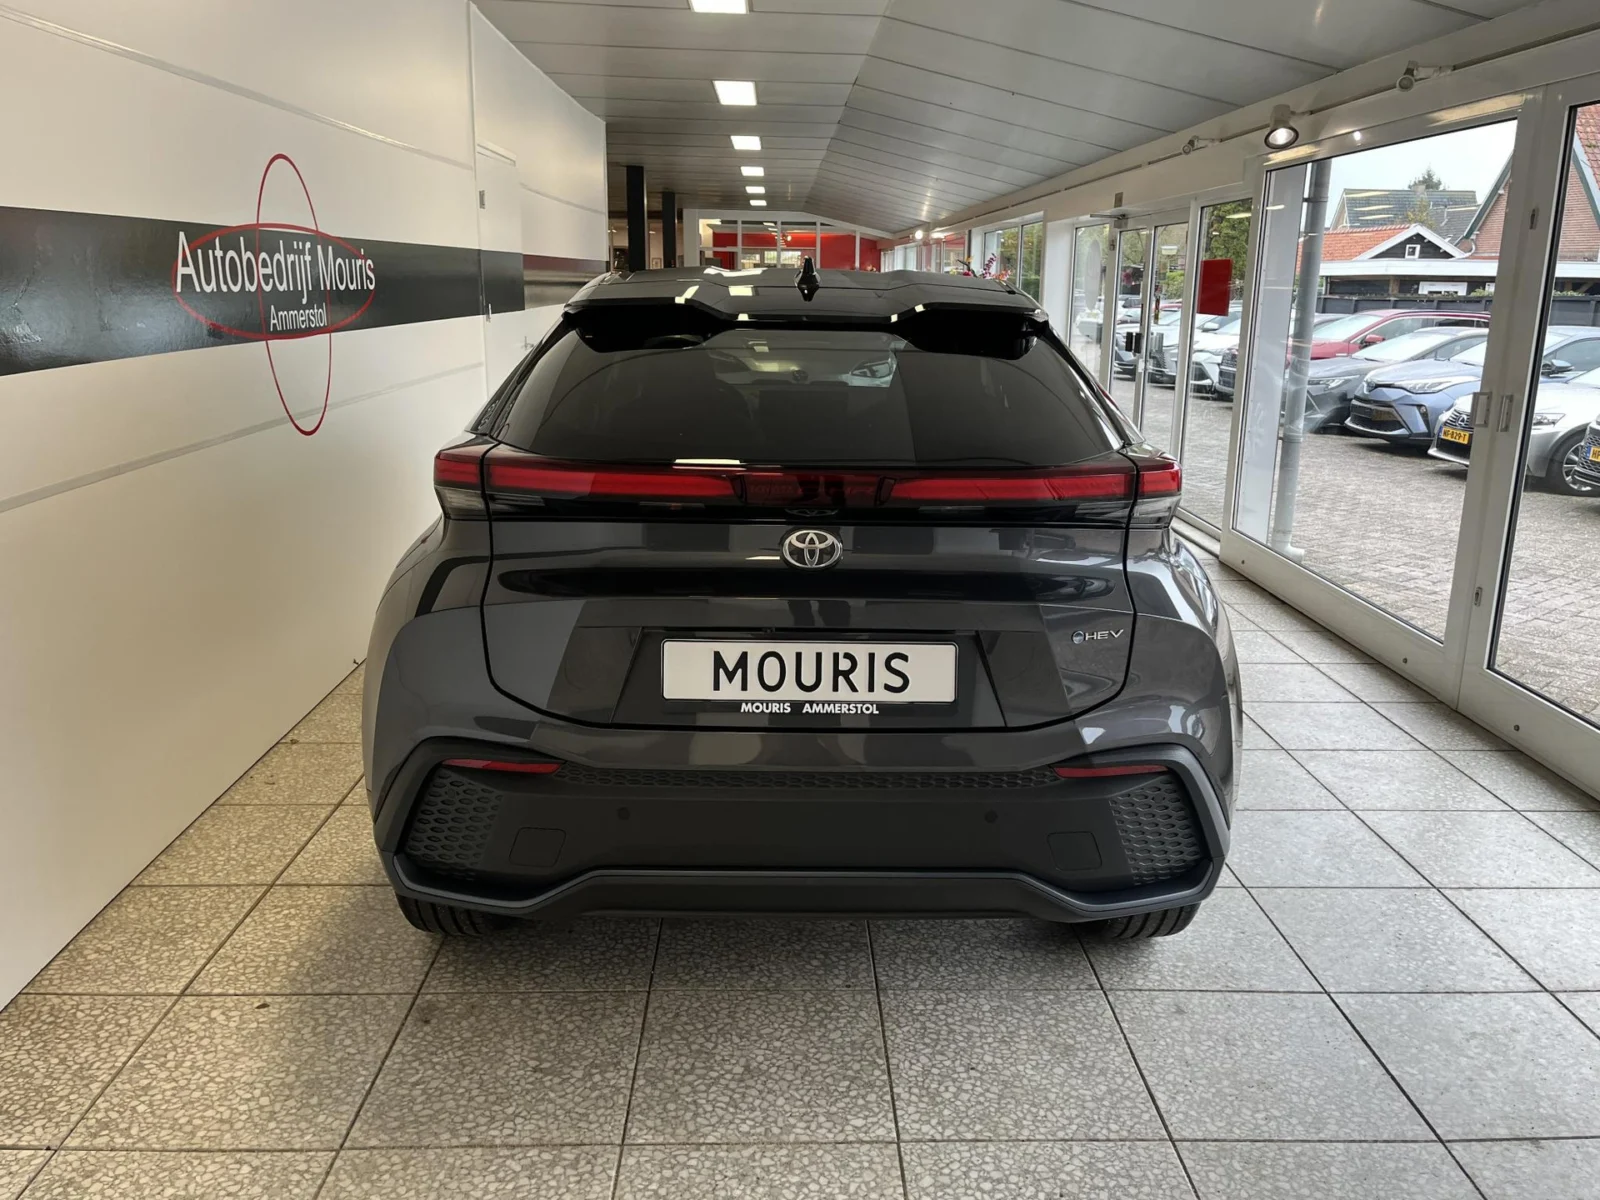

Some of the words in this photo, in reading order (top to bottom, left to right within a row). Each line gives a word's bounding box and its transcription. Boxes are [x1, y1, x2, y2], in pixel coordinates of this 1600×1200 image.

[176, 231, 312, 304] Autobedrijf
[317, 244, 376, 291] Mouris
[270, 302, 328, 332] Ammerstol
[1085, 629, 1124, 641] HEV
[712, 650, 910, 694] MOURIS
[740, 702, 791, 714] MOURIS
[802, 703, 879, 715] AMMERSTOL
